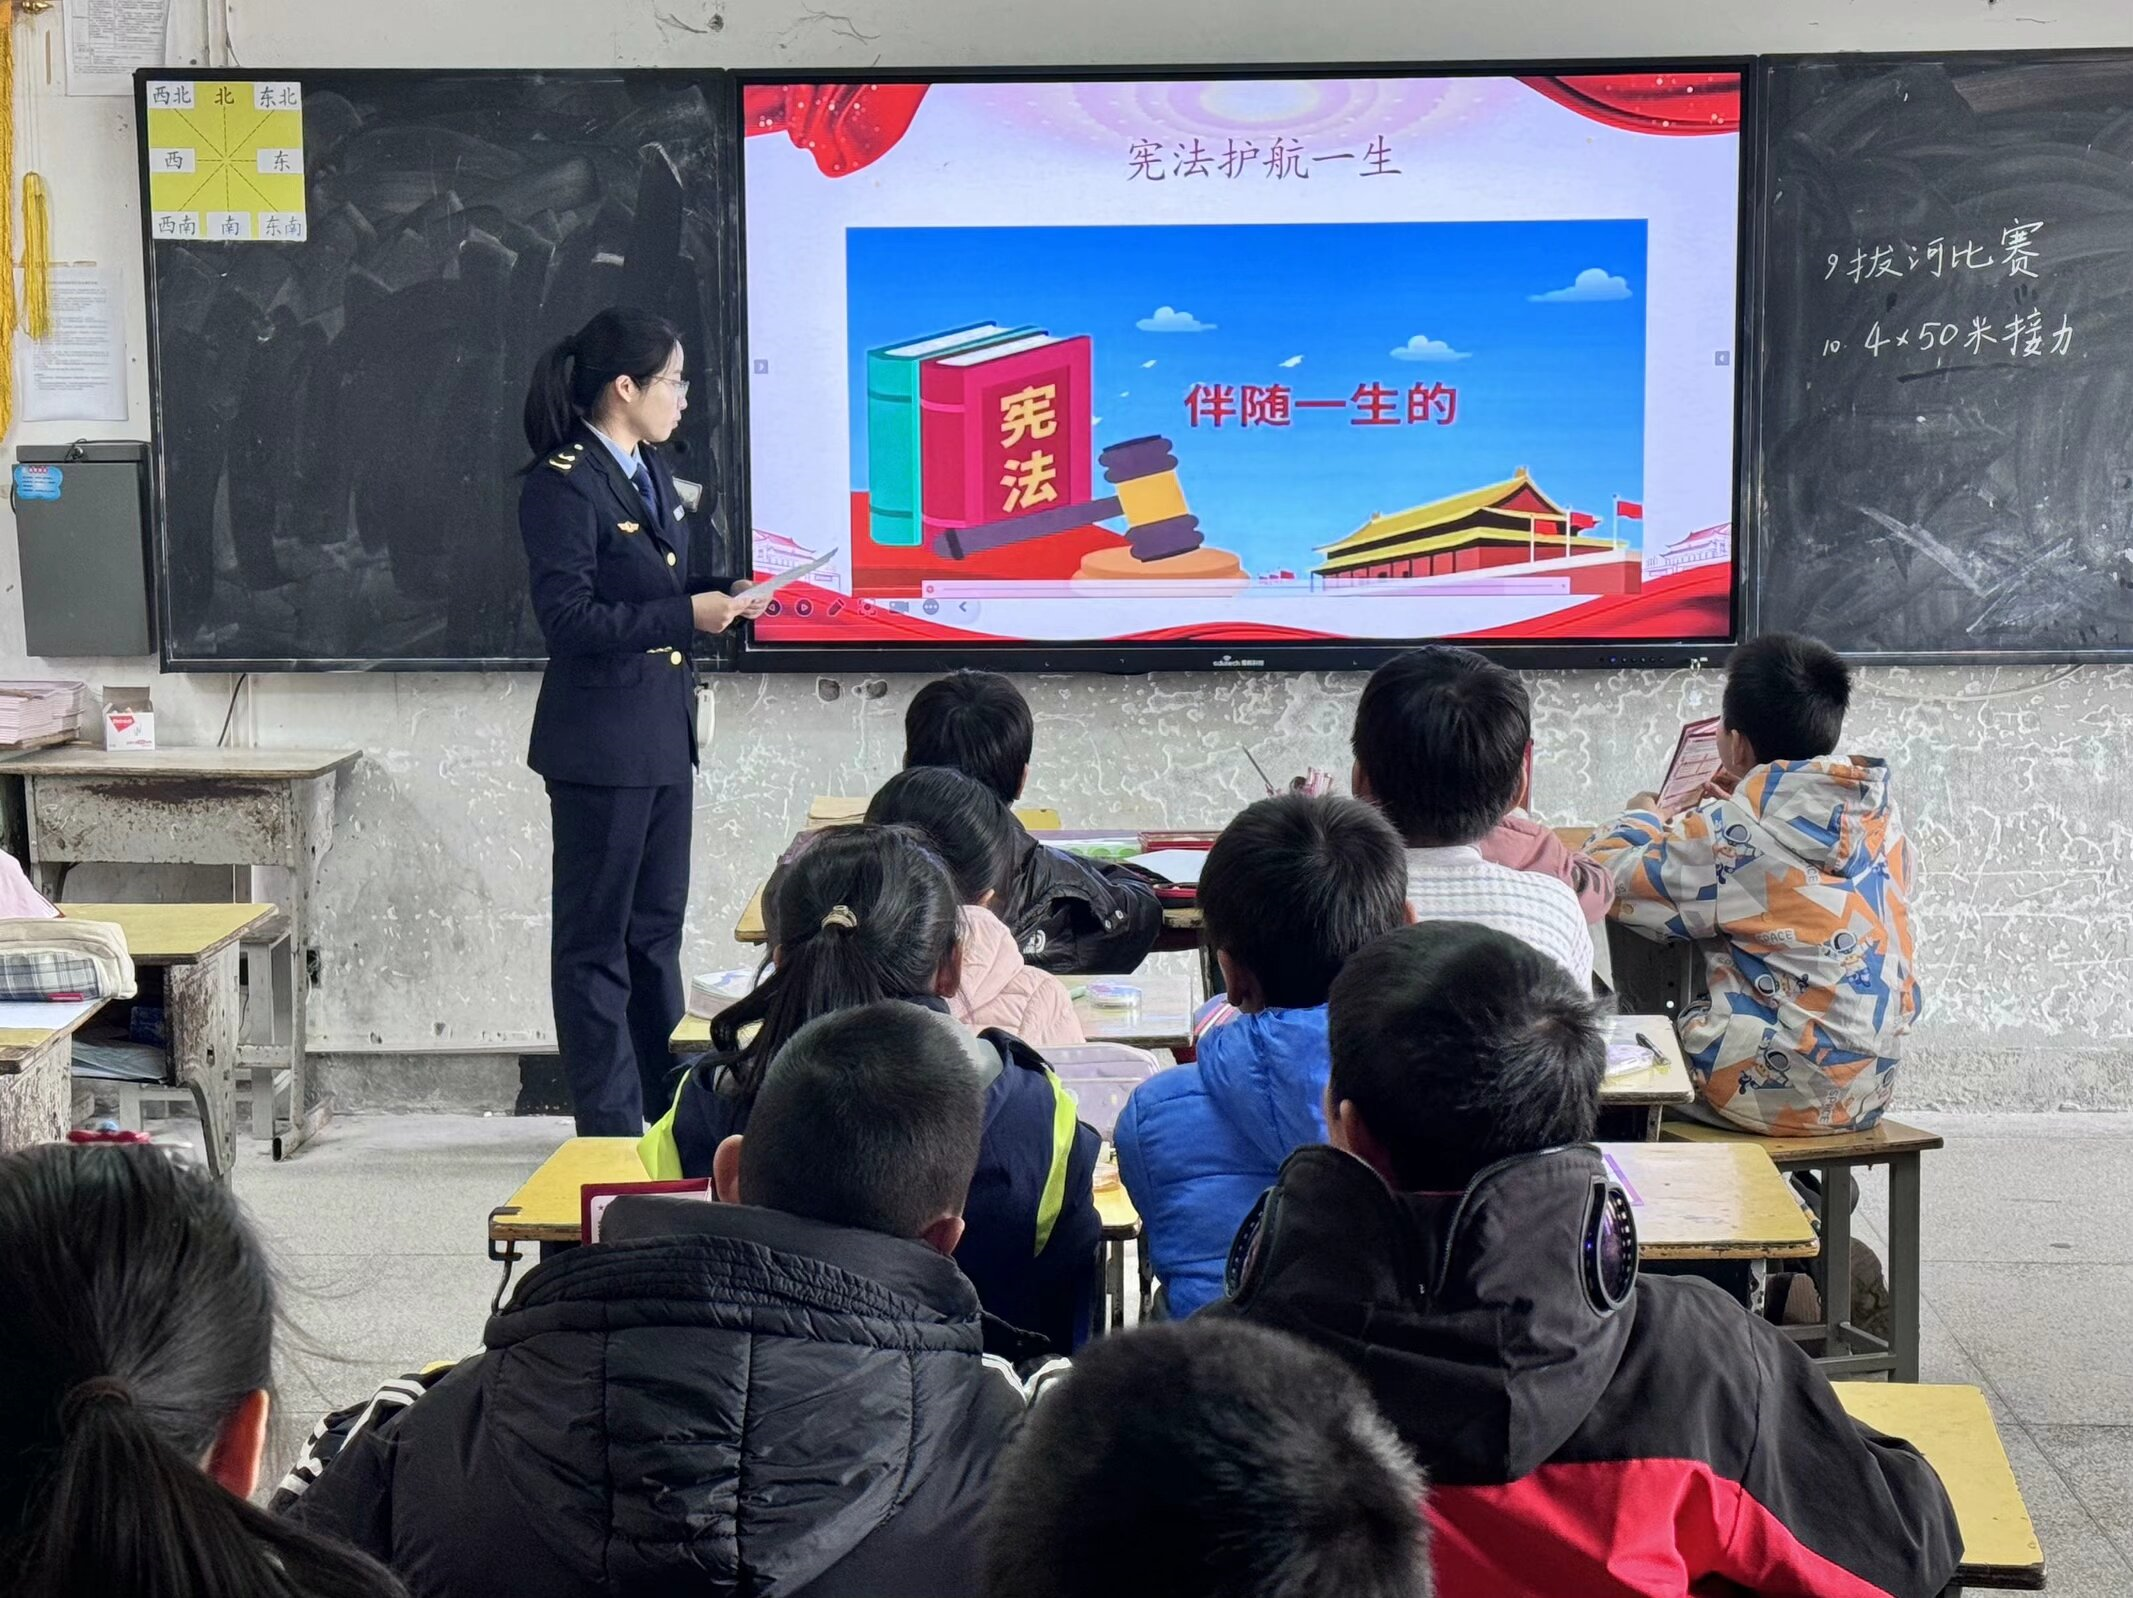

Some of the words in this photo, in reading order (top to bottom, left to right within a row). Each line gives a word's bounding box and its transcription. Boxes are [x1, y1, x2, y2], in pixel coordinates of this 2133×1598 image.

[153, 86, 191, 105] 西北
[214, 86, 235, 105] 北
[260, 86, 297, 108] 东北
[164, 151, 183, 170] 西
[273, 150, 290, 172] 东
[1127, 135, 1402, 181] 宪法护航一生
[158, 215, 196, 235] 西南
[221, 215, 239, 236] 南
[265, 215, 302, 236] 东南
[1184, 381, 1457, 428] 伴随一生的
[1000, 383, 1058, 513] 宪法
